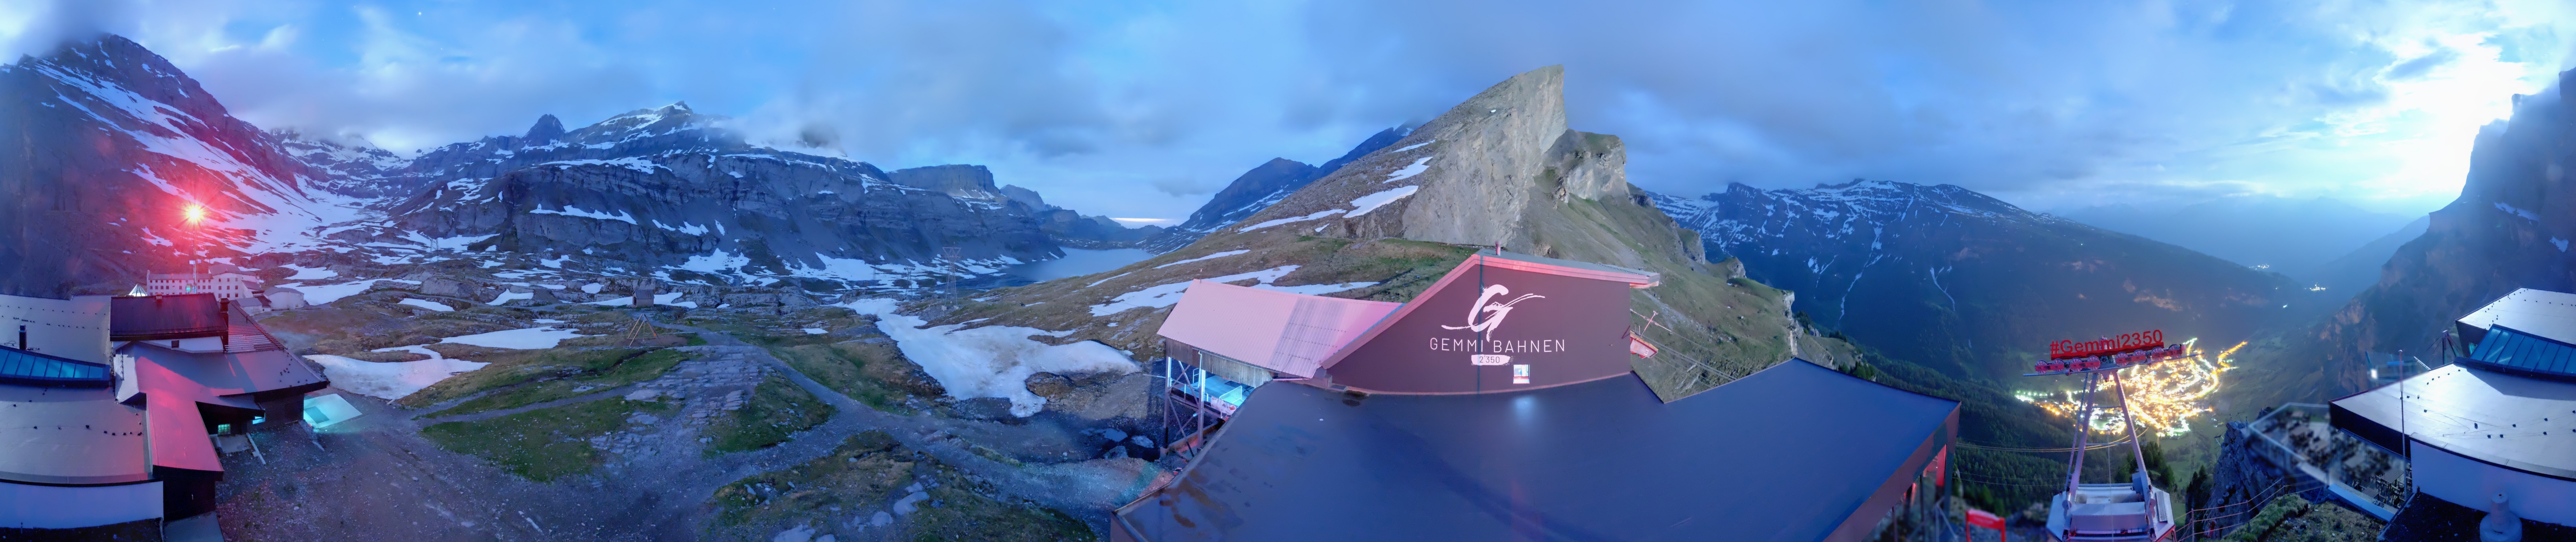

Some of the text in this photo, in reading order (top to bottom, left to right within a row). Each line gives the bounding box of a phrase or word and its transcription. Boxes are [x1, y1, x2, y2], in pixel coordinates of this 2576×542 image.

[1430, 337, 1564, 353] GEMMI BAHNEN
[2050, 329, 2162, 354] #Gemmi2350
